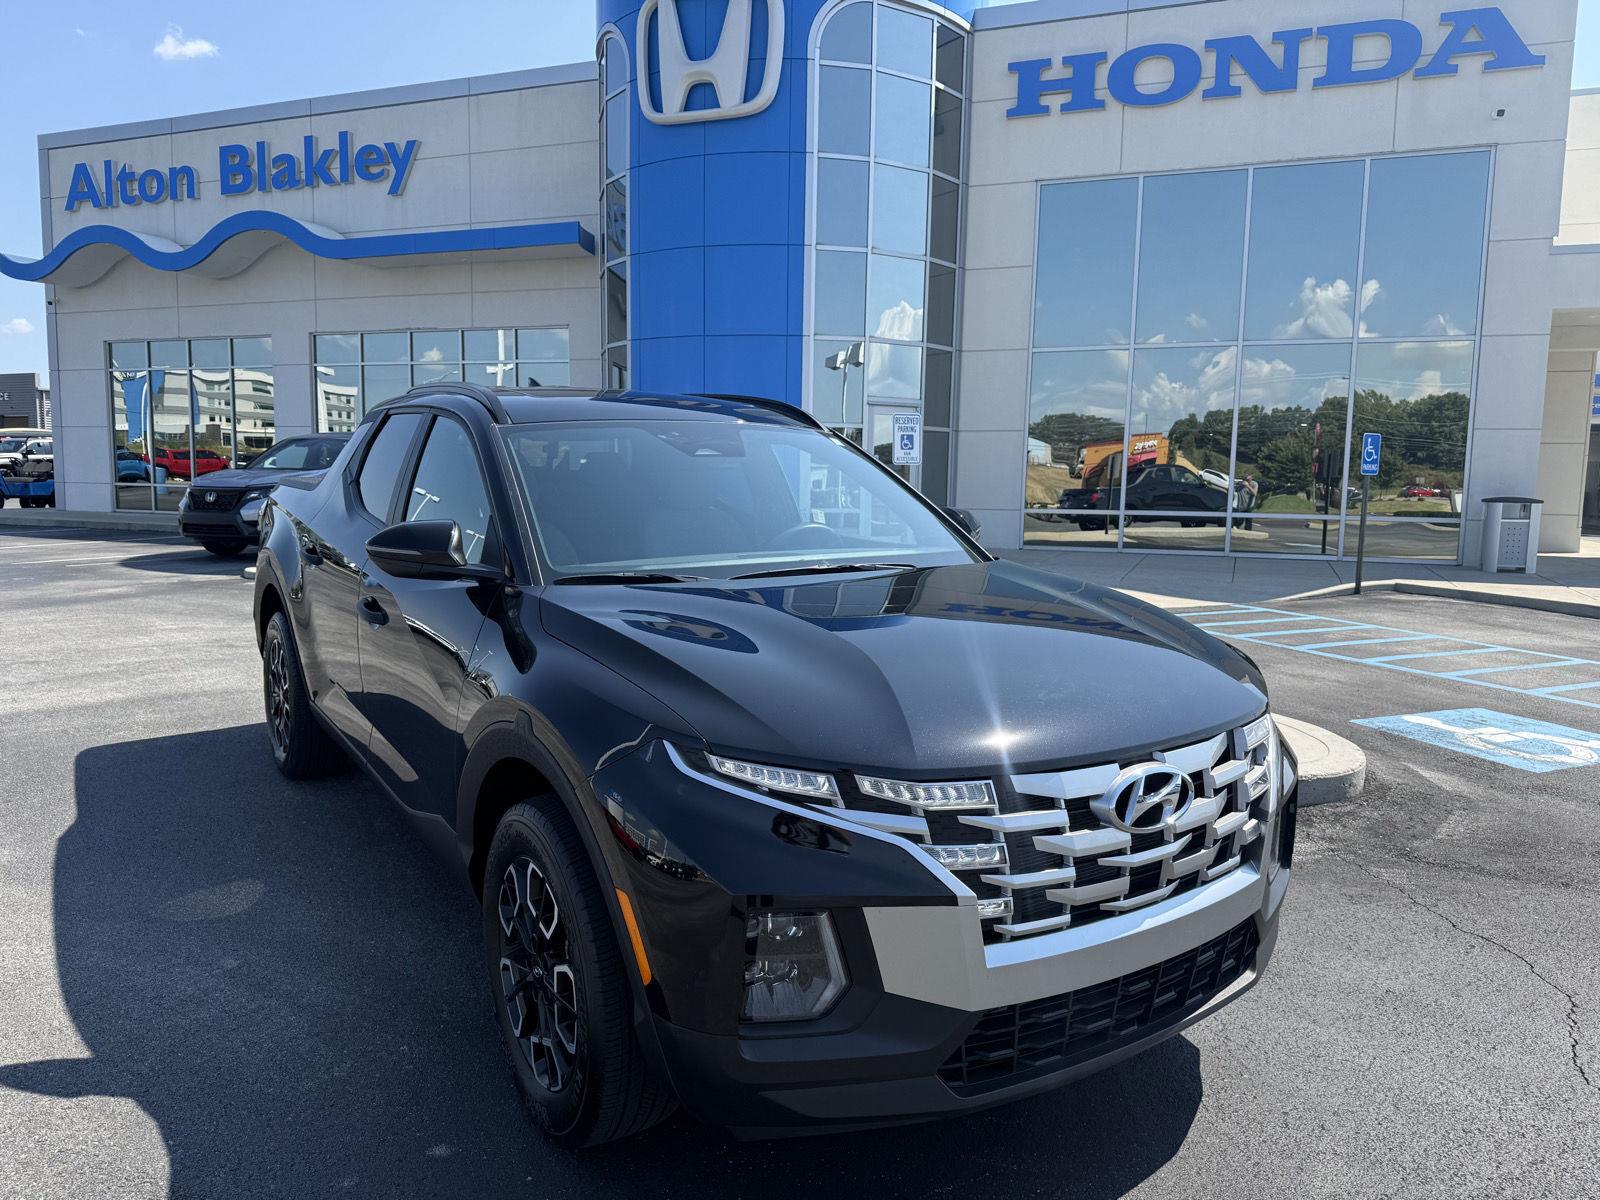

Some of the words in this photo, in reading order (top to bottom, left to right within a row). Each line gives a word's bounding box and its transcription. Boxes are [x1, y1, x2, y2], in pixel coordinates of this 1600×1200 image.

[1006, 7, 1545, 118] HONDA
[64, 159, 199, 213] Alton
[218, 130, 420, 197] Blakley
[895, 416, 919, 425] RESERVED
[897, 425, 917, 433] PARKING
